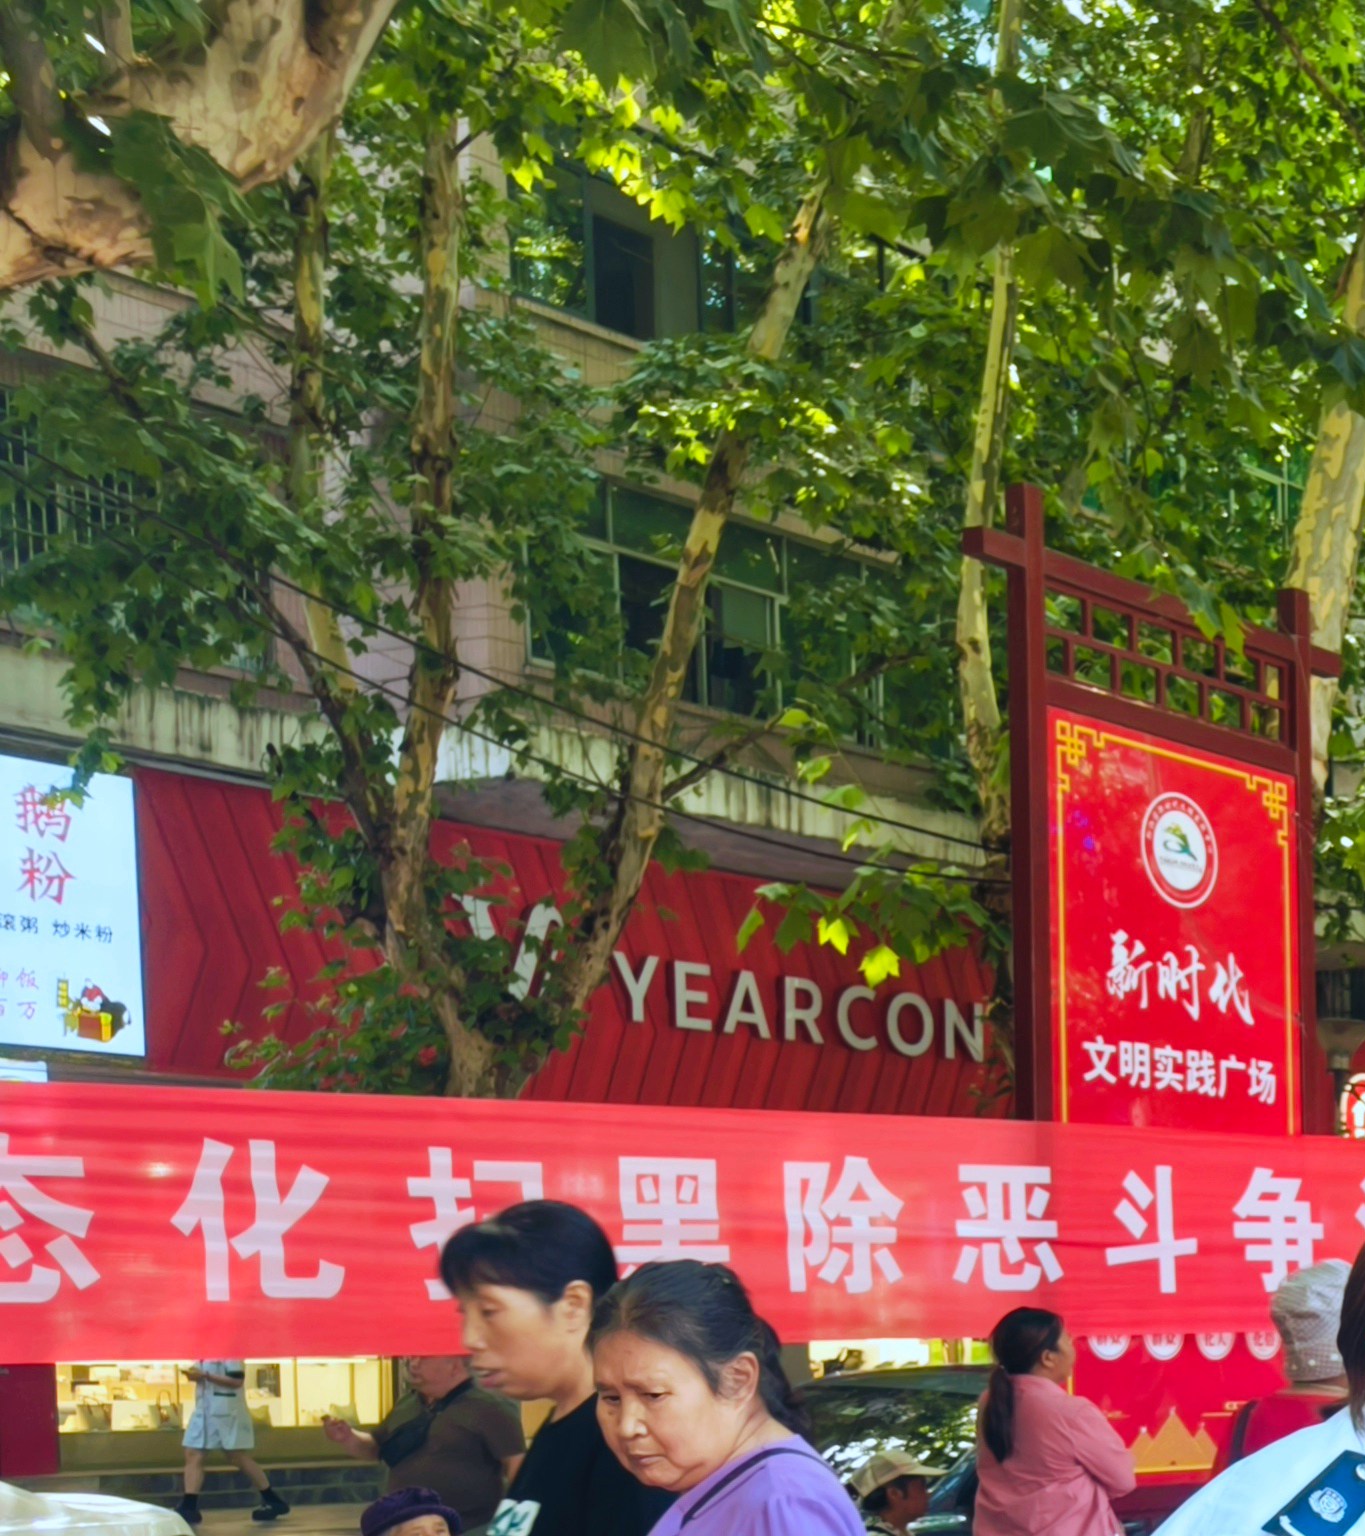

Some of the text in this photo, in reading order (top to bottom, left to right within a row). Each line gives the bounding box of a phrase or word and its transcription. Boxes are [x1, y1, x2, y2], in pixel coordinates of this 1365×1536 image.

[52, 919, 113, 944] 炒米粉
[613, 950, 984, 1063] YEARCON
[1105, 928, 1255, 1026] 新时代
[1081, 1034, 1277, 1105] 文明实践广场
